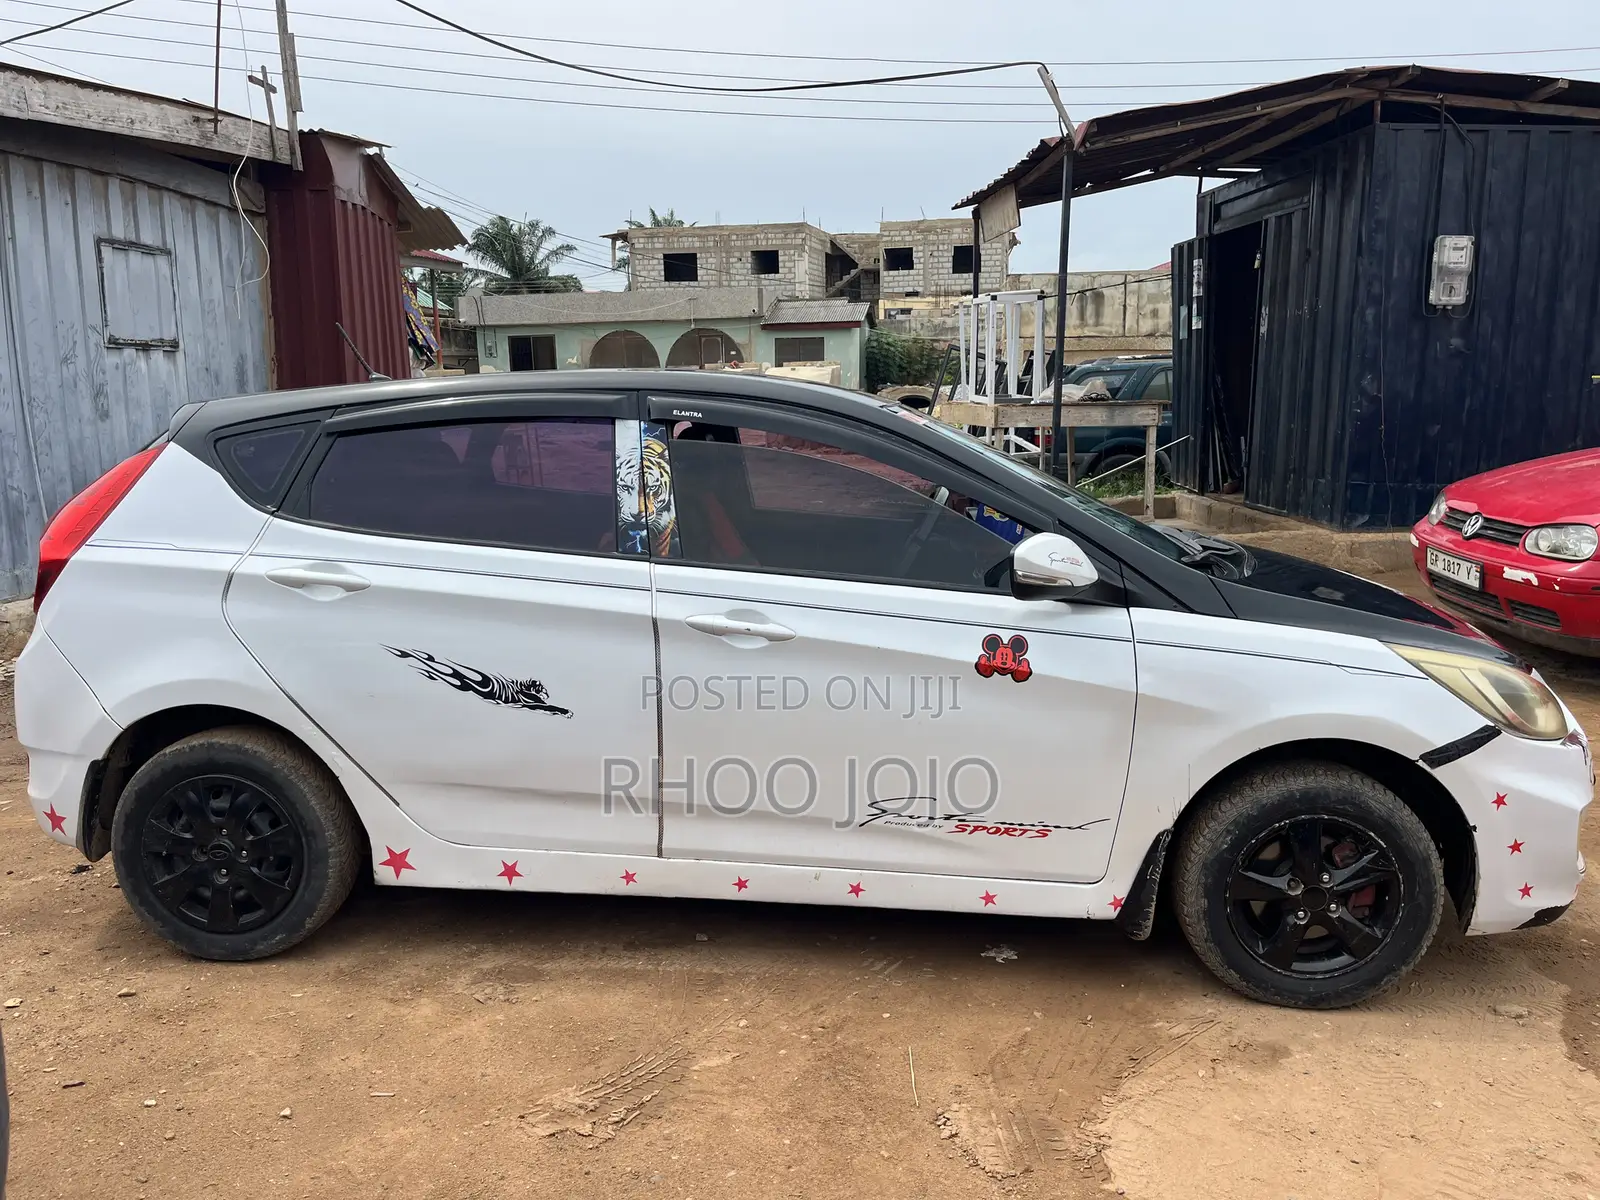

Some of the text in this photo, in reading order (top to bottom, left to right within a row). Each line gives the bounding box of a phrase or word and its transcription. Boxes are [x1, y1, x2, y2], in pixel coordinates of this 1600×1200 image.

[673, 409, 703, 418] ELANTRA
[1429, 552, 1440, 568] GR
[1442, 557, 1461, 576] 1817
[1466, 565, 1472, 580] Y
[884, 820, 930, 829] Produced
[945, 823, 1053, 839] SPORTS
